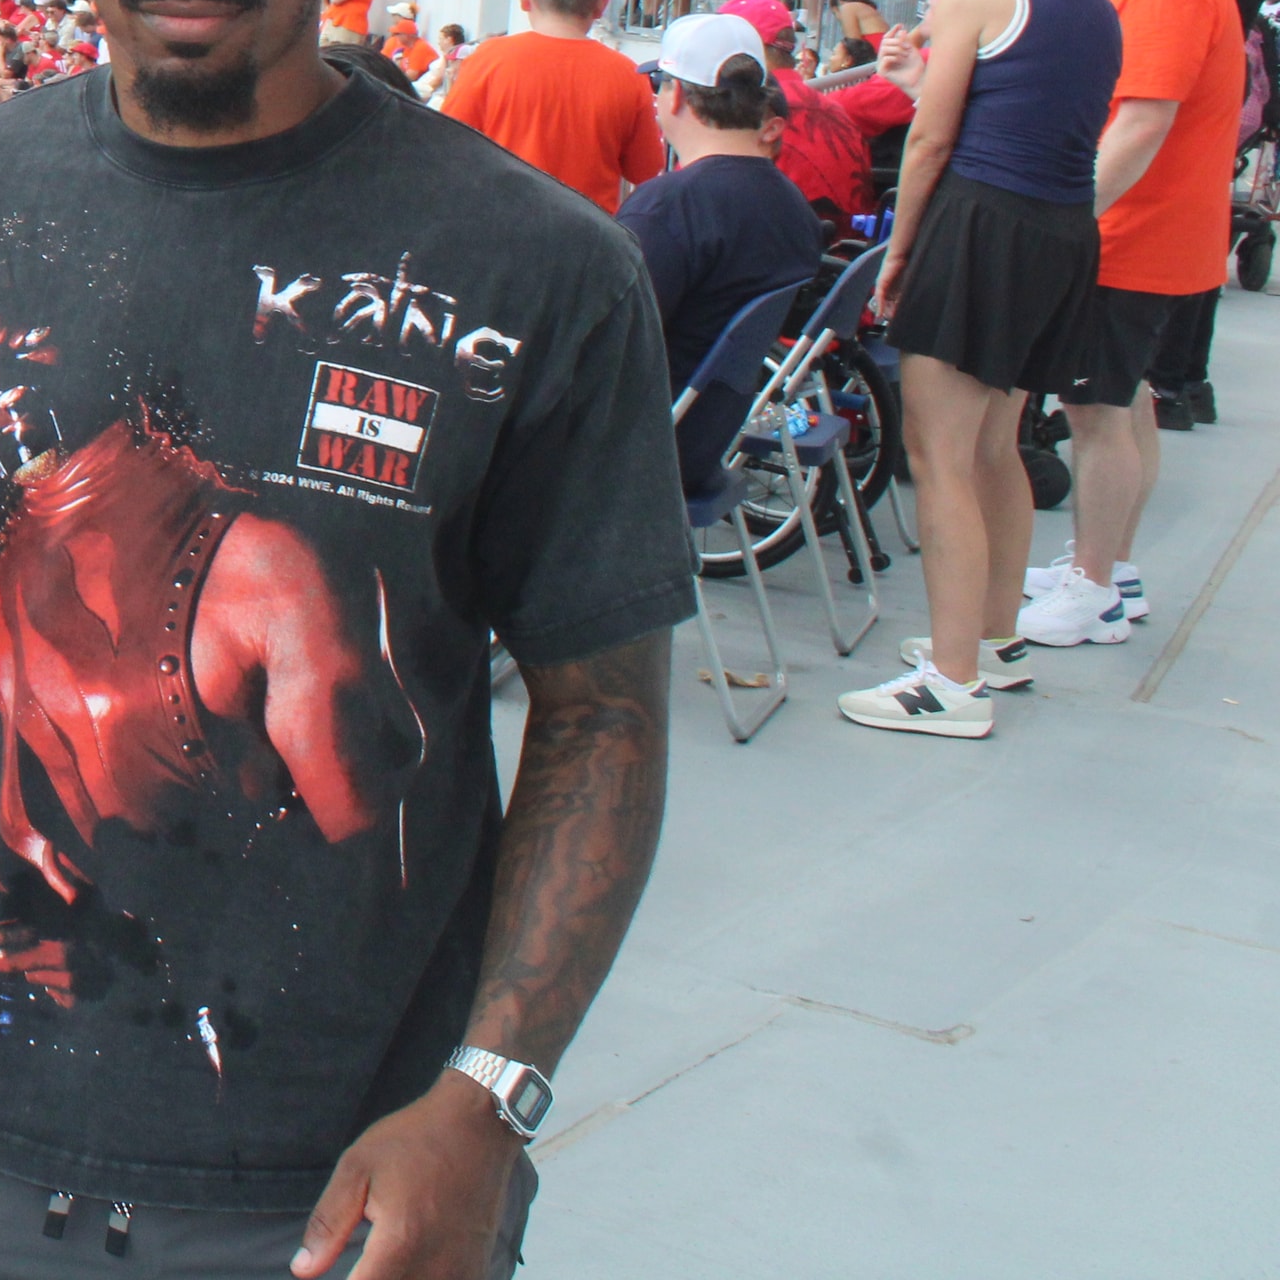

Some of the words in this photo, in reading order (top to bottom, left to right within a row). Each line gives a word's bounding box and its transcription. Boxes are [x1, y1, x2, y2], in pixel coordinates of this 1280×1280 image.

[324, 369, 429, 422] RAW
[356, 416, 382, 437] IS
[318, 434, 410, 487] WAR
[262, 472, 295, 486] 2024
[298, 476, 335, 493] WWE.
[337, 485, 355, 498] All
[357, 489, 394, 508] Rights
